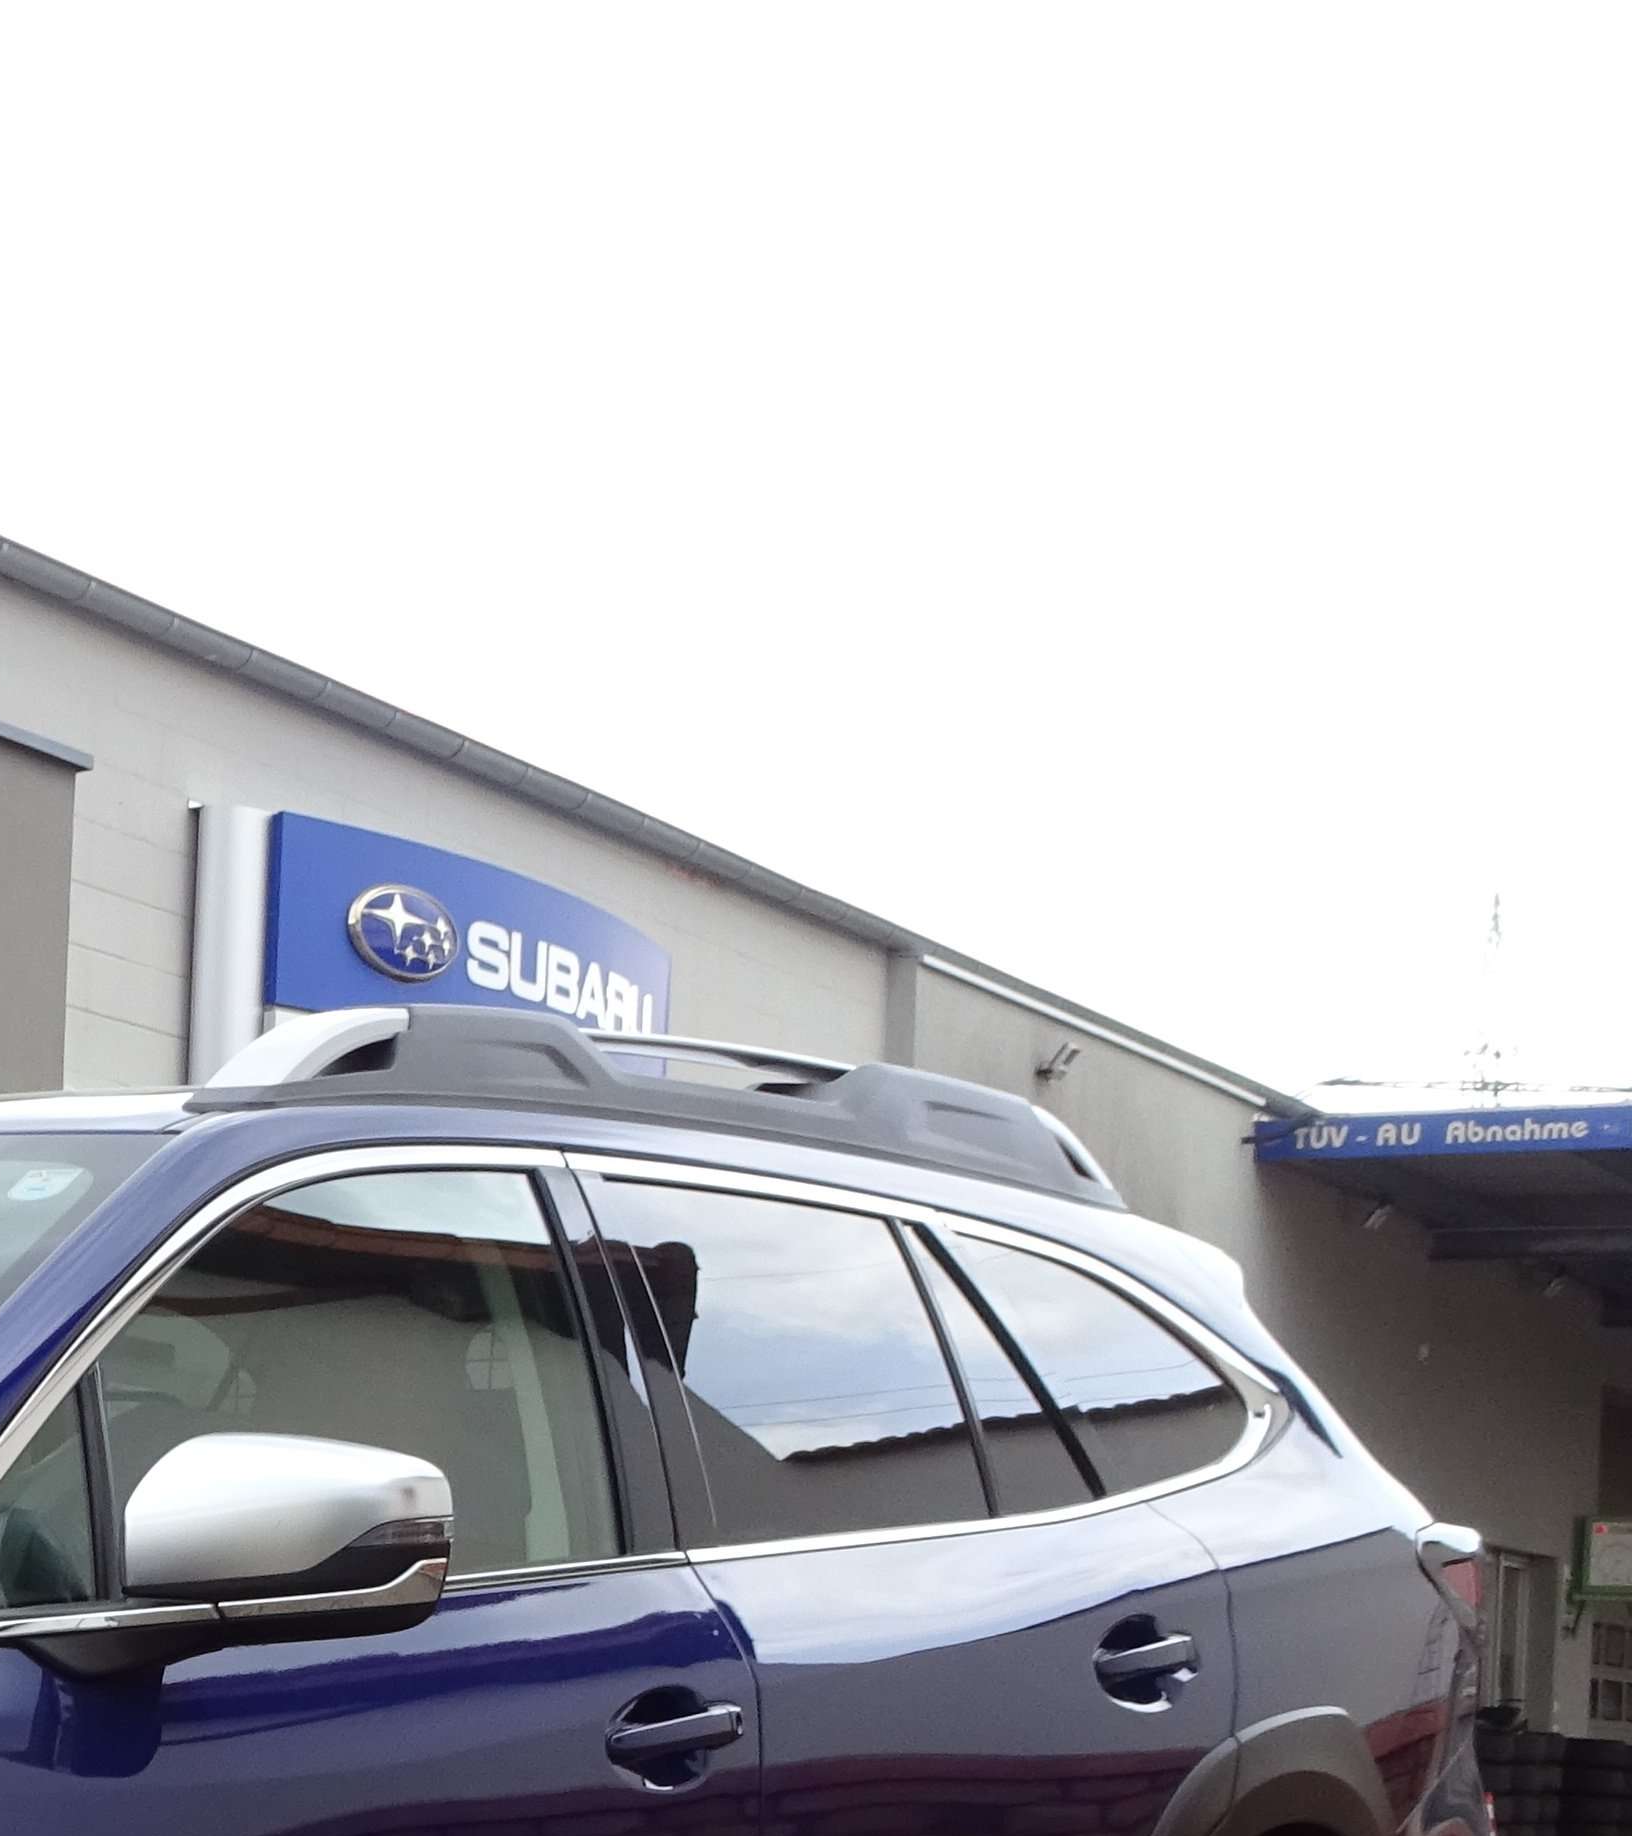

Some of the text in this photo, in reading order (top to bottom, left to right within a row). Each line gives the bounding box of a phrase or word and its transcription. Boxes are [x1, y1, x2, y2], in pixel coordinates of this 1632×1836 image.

[466, 920, 654, 1035] SUBARU
[1294, 1120, 1349, 1150] TÜV
[1376, 1123, 1422, 1146] AU
[1445, 1118, 1589, 1145] Abnahme
